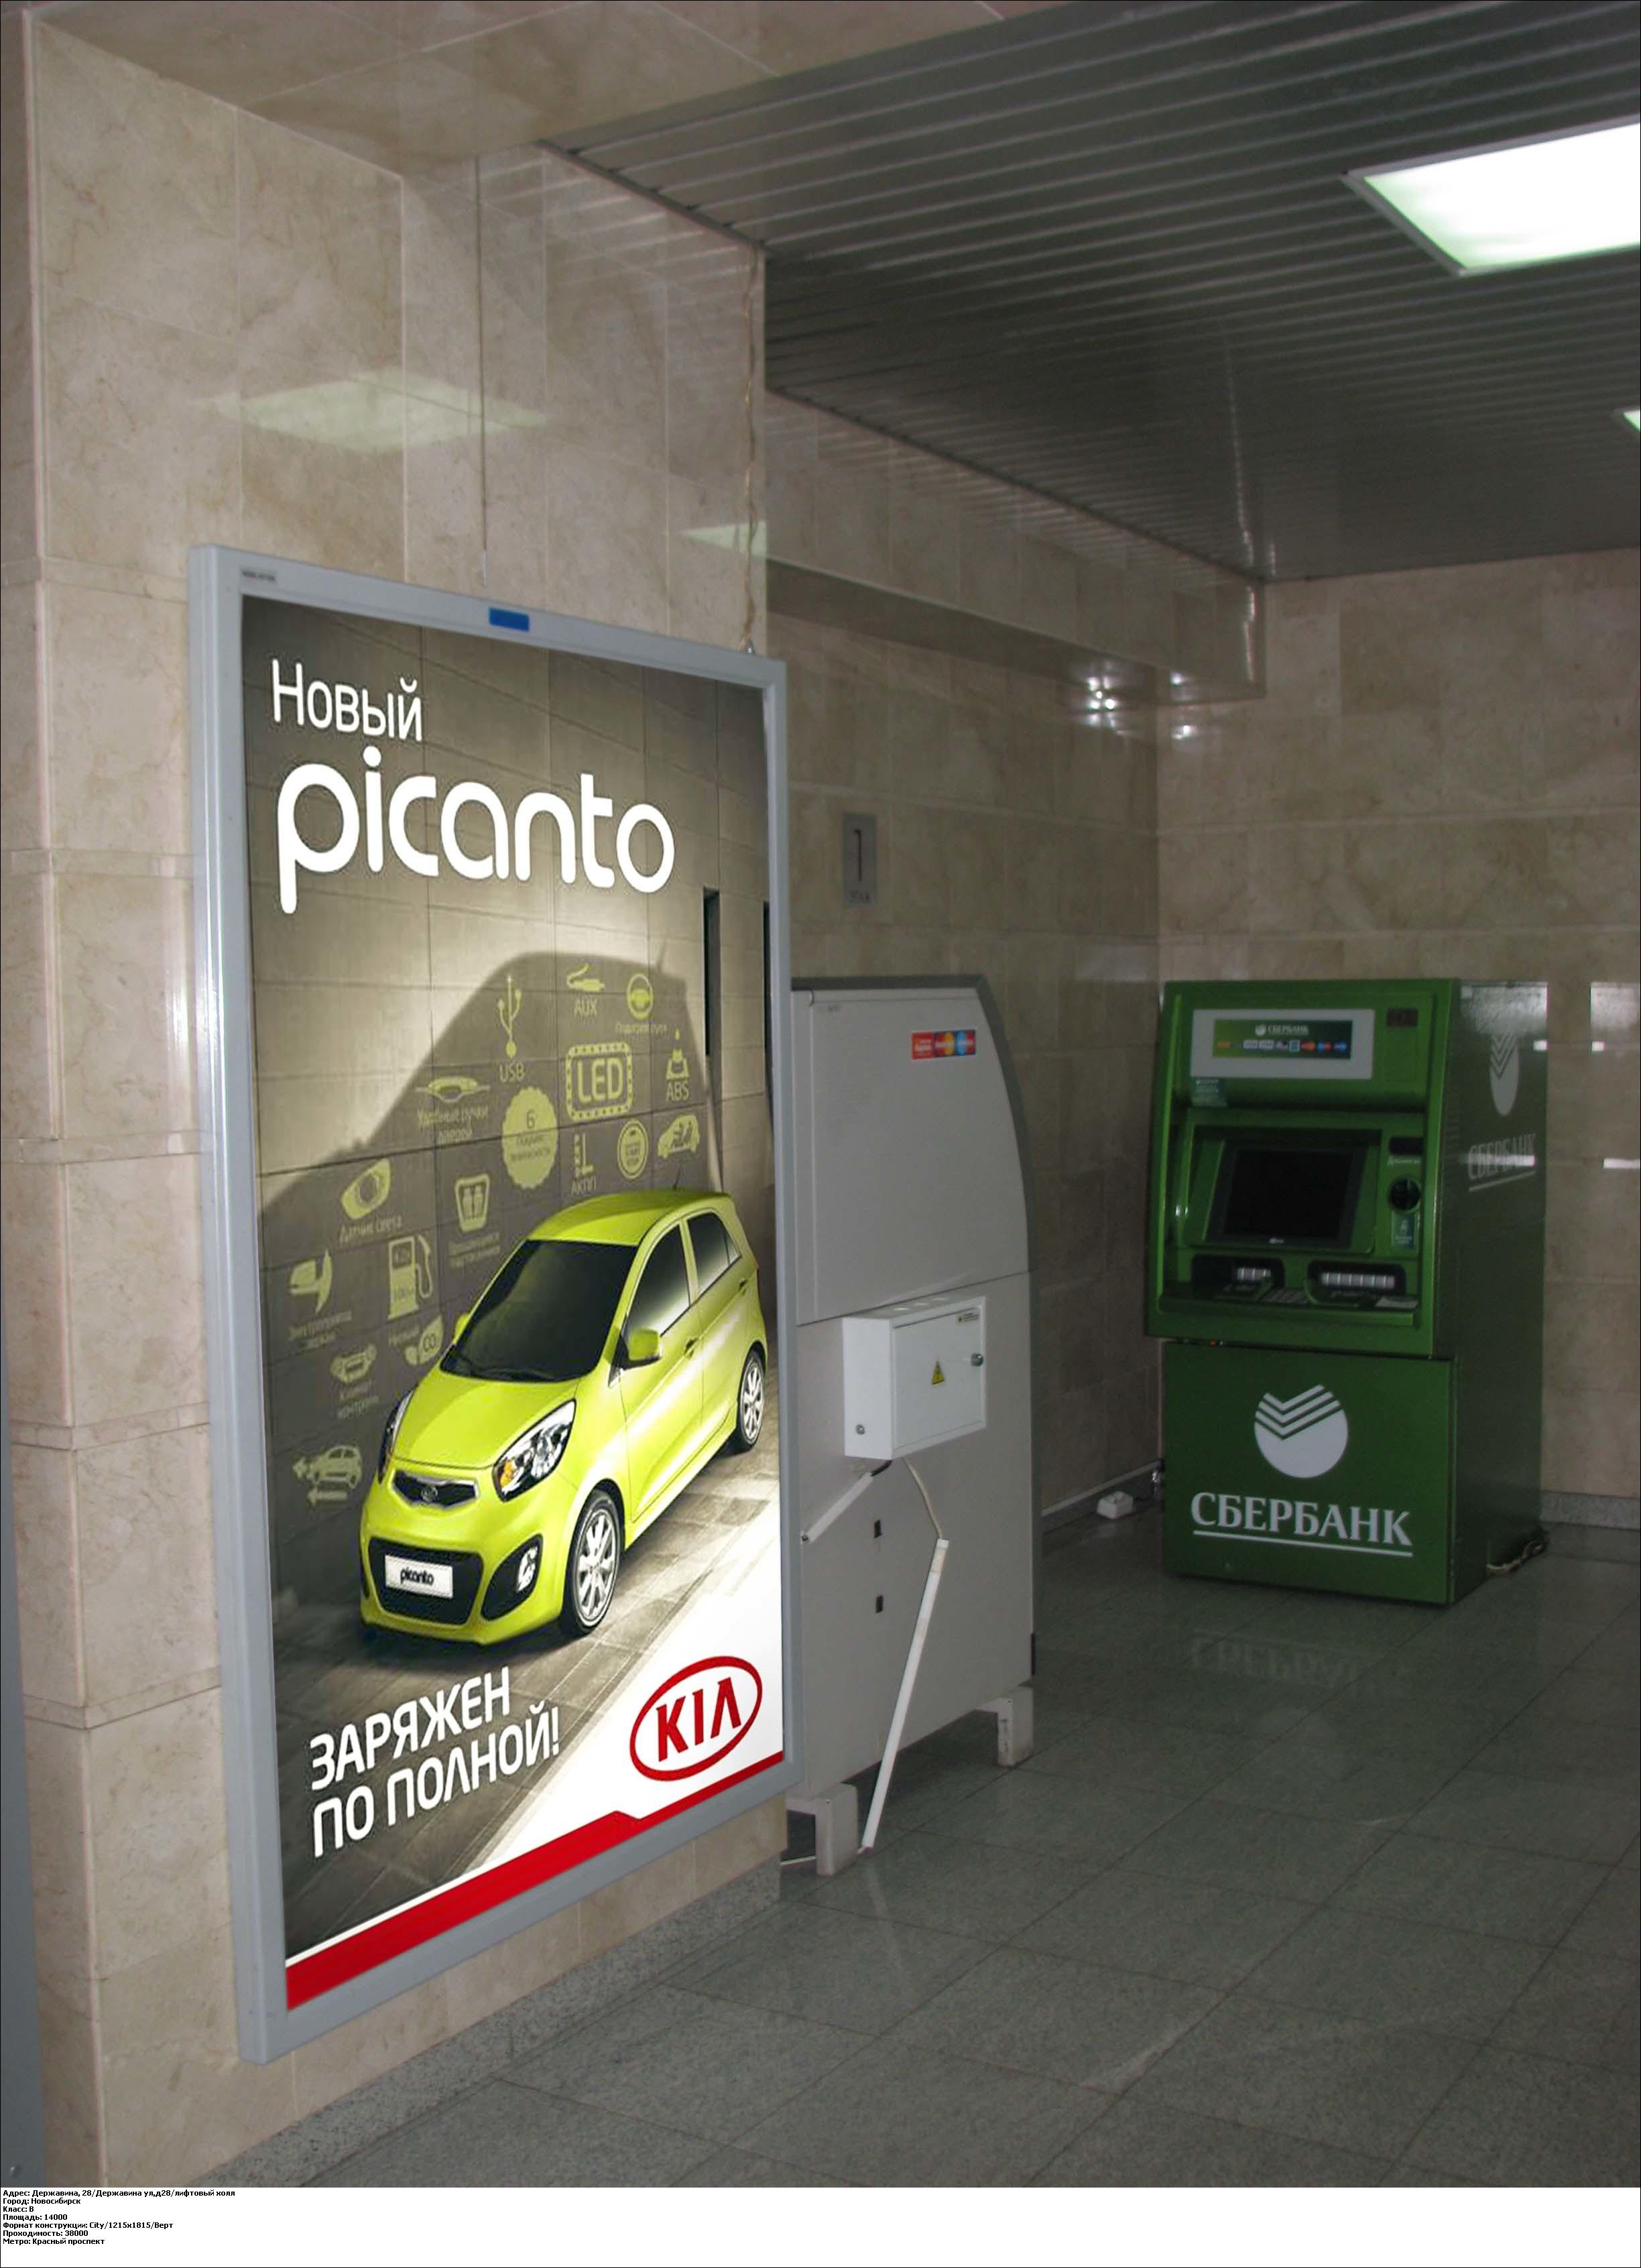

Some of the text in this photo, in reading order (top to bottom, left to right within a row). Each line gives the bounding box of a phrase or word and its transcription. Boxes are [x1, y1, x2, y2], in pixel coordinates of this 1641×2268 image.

[272, 659, 422, 741] Новый
[277, 745, 675, 914] picanto
[574, 997, 597, 1017] AUX
[499, 1063, 526, 1082] USB
[576, 1058, 624, 1104] LED
[666, 1082, 690, 1102] ABS
[526, 1109, 536, 1129] 6
[1191, 1492, 1412, 1546] СБЕРБАНК
[400, 1566, 435, 1586] picanto
[310, 1666, 510, 1791] ЗАРЯЖЕН
[656, 1677, 741, 1762] KIA
[314, 1699, 559, 1858] ПО ПОЛНОЙ!
